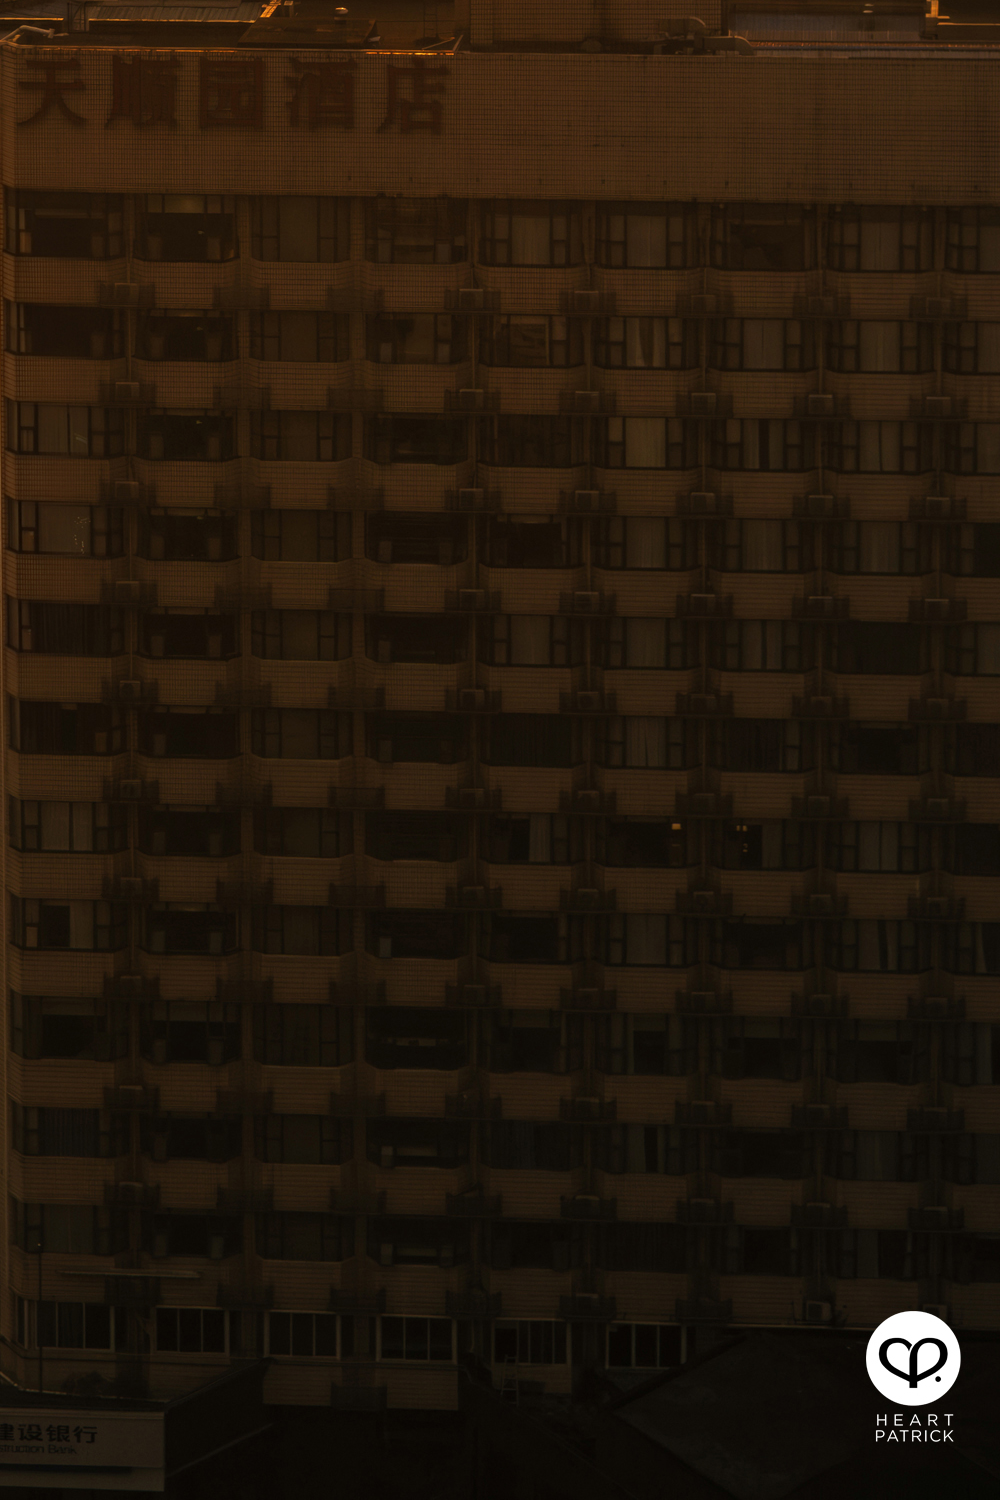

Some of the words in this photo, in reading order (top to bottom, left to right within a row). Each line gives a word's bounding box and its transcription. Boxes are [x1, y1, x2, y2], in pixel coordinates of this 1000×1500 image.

[17, 55, 449, 134] 天顺园酒店
[48, 1444, 78, 1455] Bank
